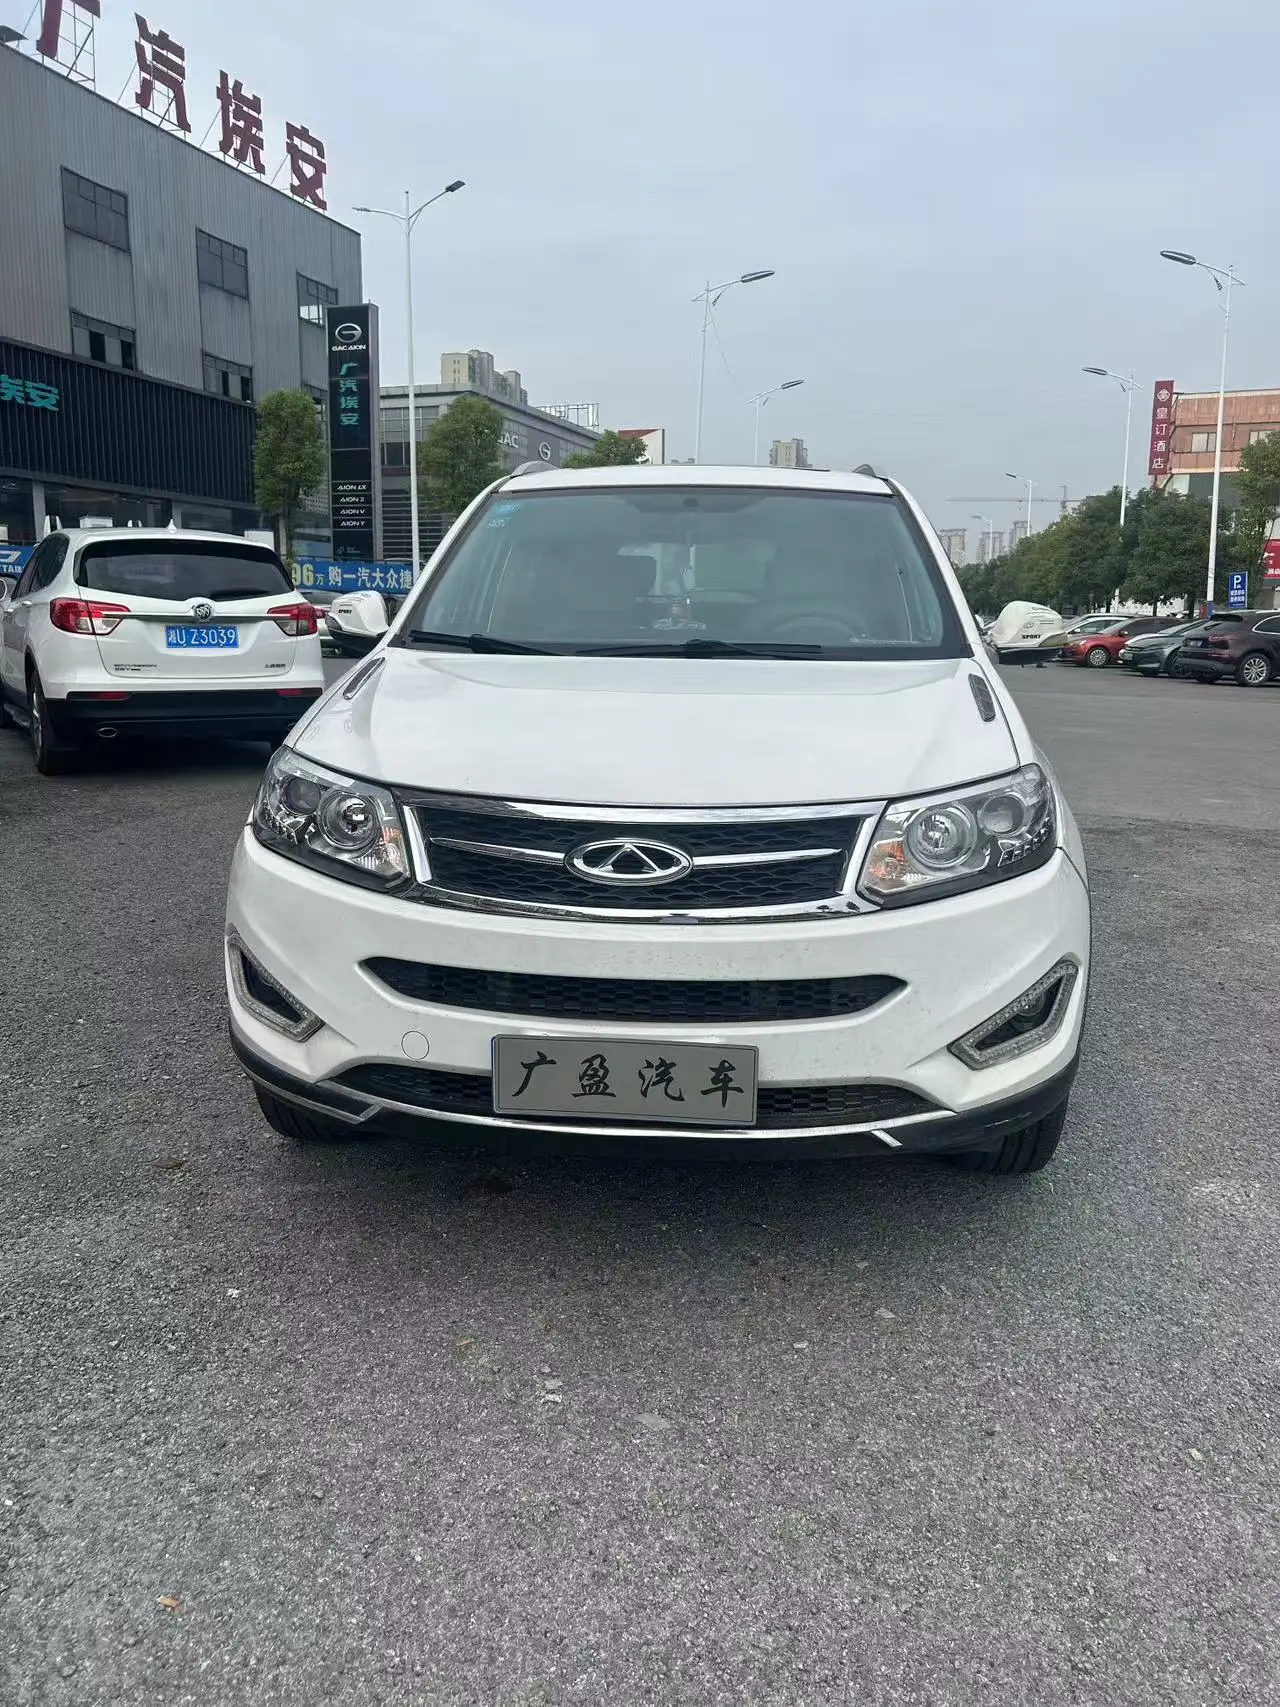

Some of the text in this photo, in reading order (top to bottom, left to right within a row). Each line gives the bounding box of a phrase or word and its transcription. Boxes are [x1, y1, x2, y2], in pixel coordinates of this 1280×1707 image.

[36, 0, 328, 211] 广汽埃安
[340, 362, 358, 425] 广汽埃安
[1233, 574, 1242, 589] P
[512, 1050, 744, 1108] 广盈汽车
